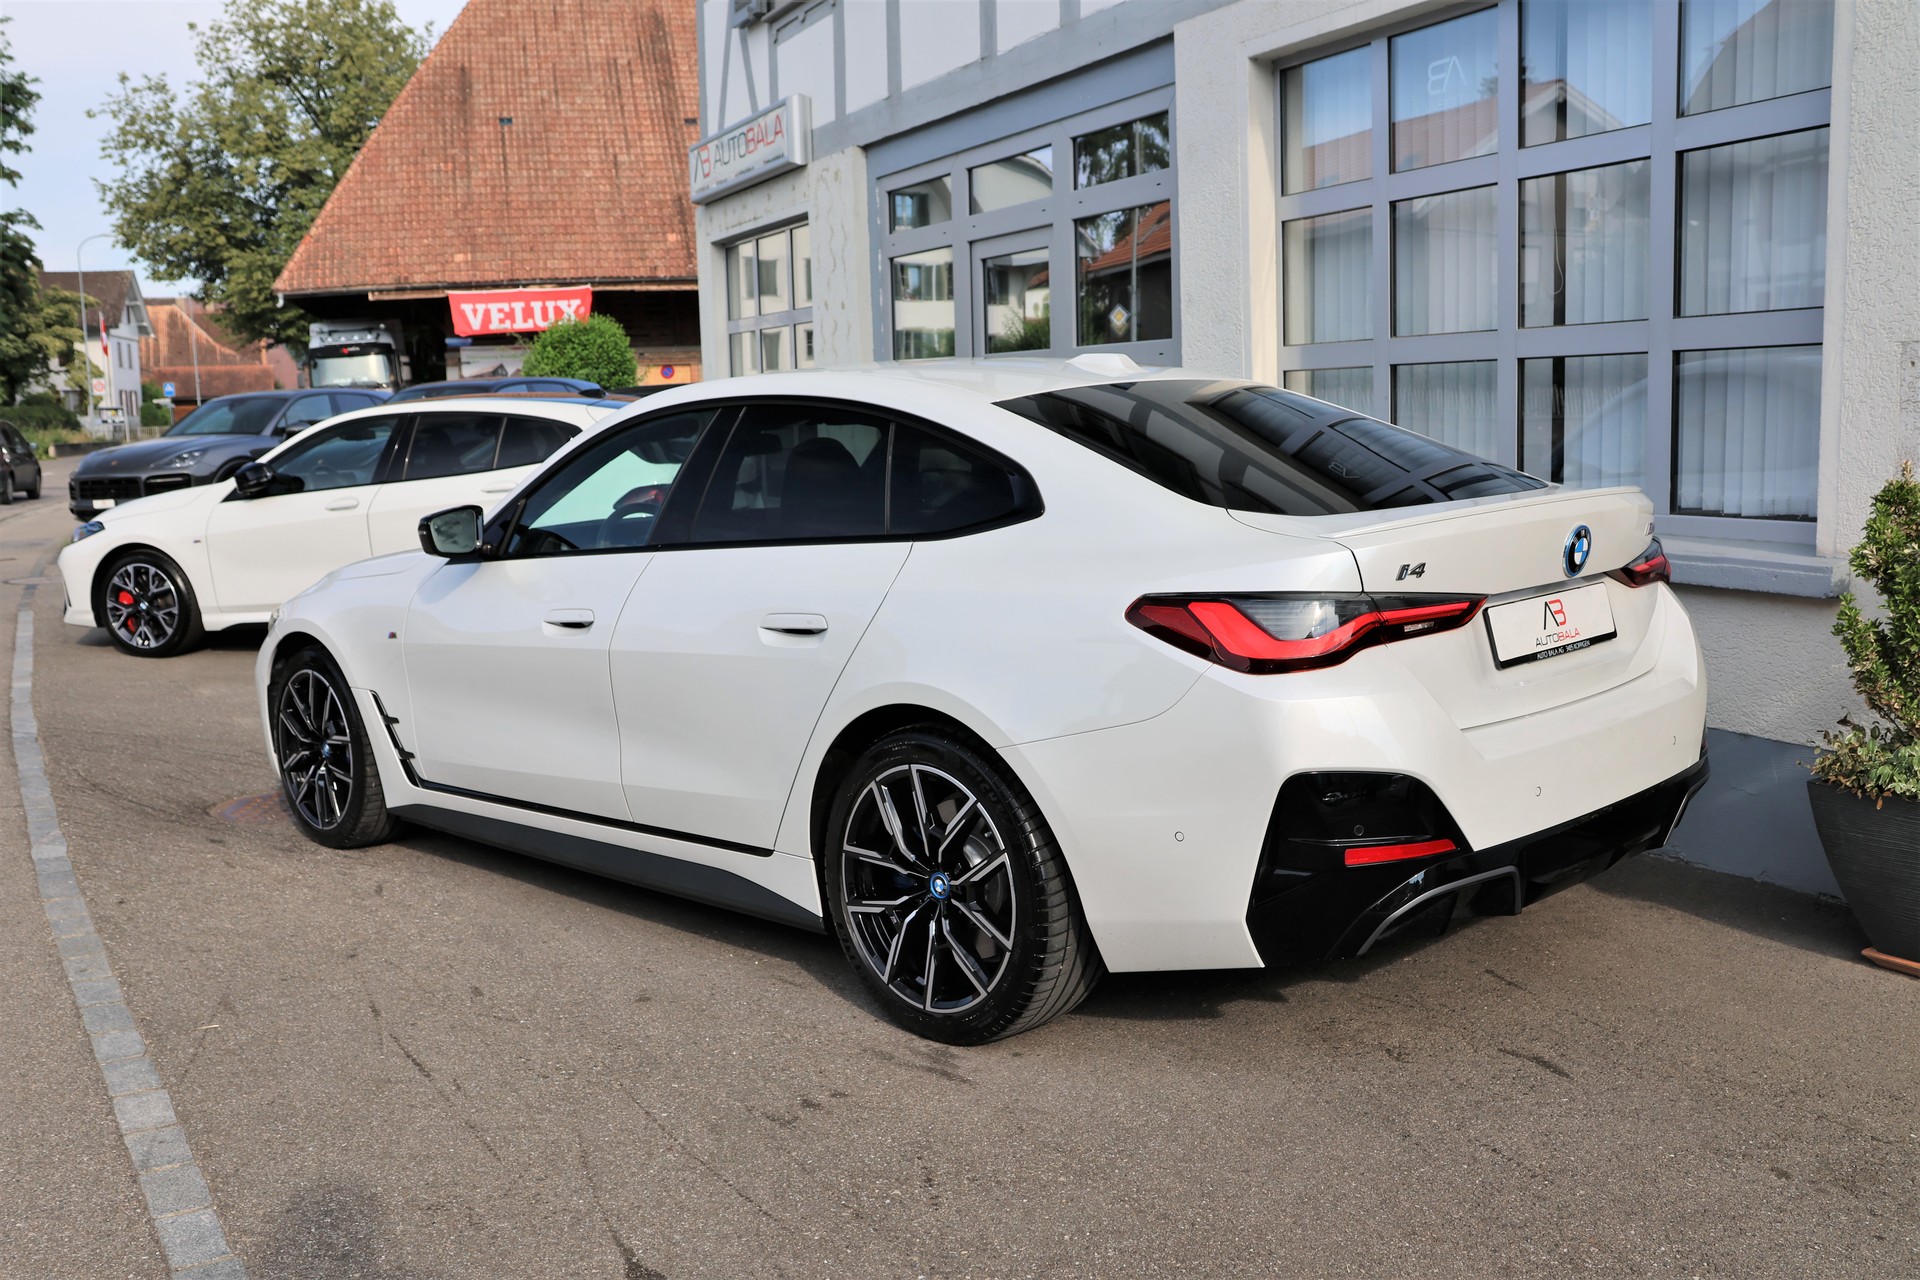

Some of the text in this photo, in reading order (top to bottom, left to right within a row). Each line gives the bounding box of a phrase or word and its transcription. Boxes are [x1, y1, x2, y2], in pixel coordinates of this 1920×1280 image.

[713, 114, 784, 170] AUTOBALA
[460, 299, 581, 331] VELUX
[1395, 563, 1426, 581] i4
[1535, 628, 1581, 648] AUTOBALA
